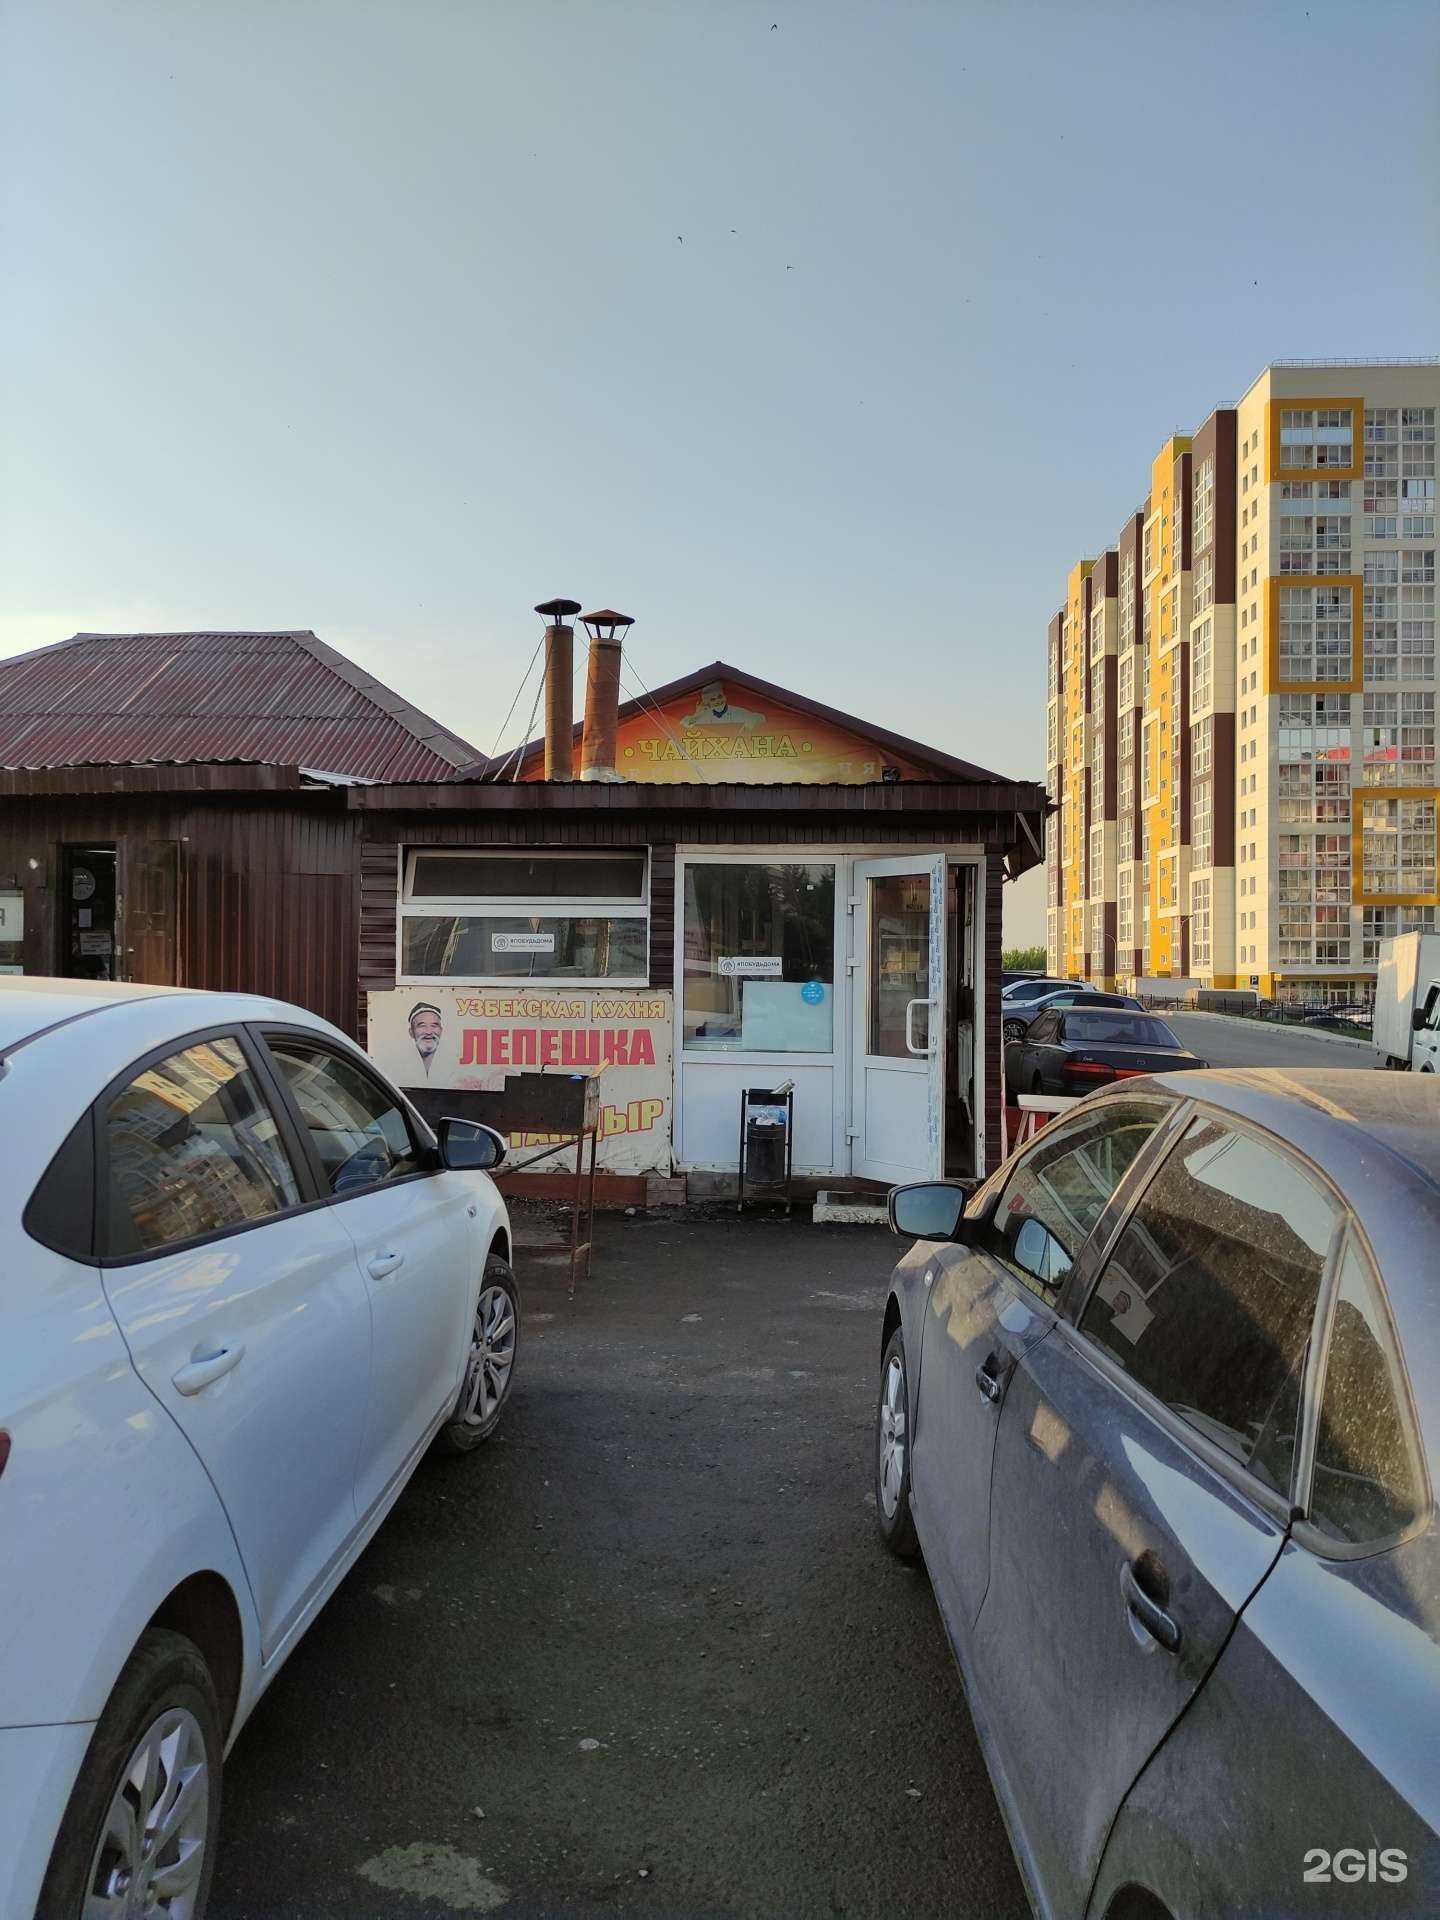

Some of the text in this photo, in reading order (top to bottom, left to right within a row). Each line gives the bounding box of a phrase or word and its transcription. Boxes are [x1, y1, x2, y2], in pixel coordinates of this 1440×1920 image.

[638, 730, 799, 761] ЧАЙХАНА
[456, 998, 666, 1019] УЗБЕКСКАЯ КУХНЯ
[459, 1029, 656, 1065] ЛЕПЕШКА
